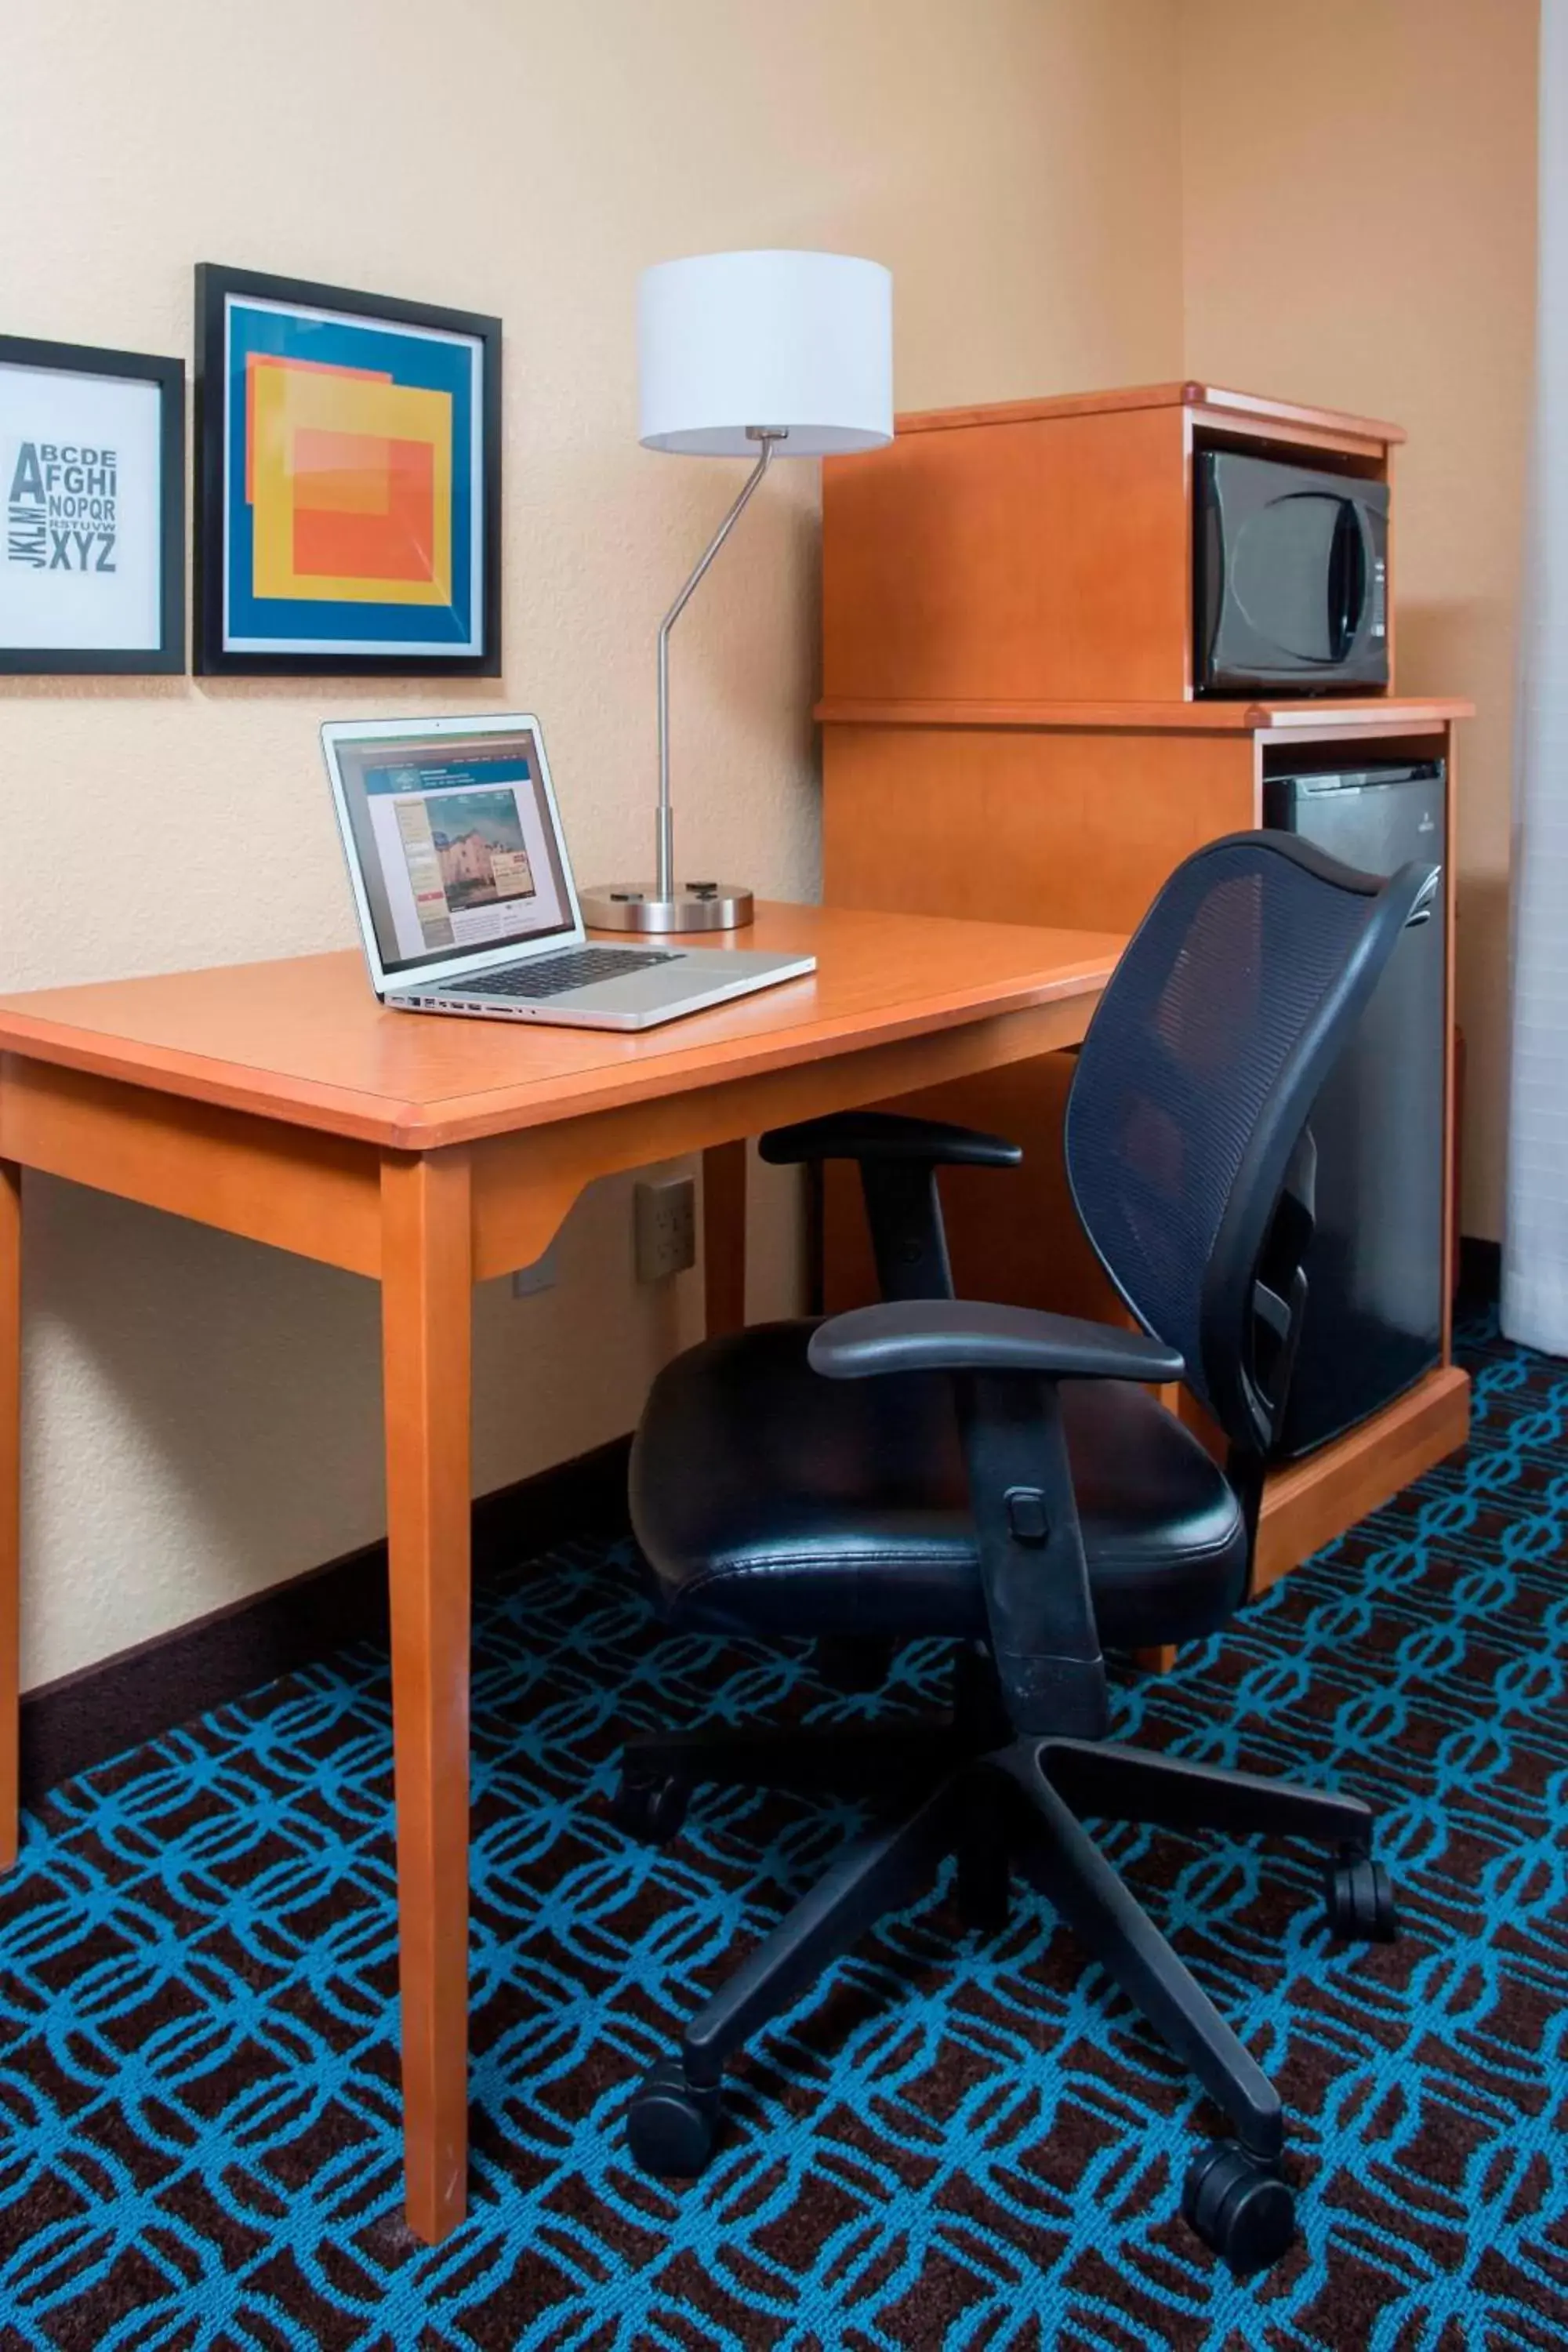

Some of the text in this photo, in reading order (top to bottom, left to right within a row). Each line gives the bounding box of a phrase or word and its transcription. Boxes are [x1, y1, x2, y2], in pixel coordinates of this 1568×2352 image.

[9, 442, 46, 504] A
[40, 444, 116, 468] BCDE
[45, 464, 116, 497] FGHI
[49, 495, 115, 521] NOPQR
[8, 506, 46, 568] JKLM
[49, 530, 116, 572] XYZ
